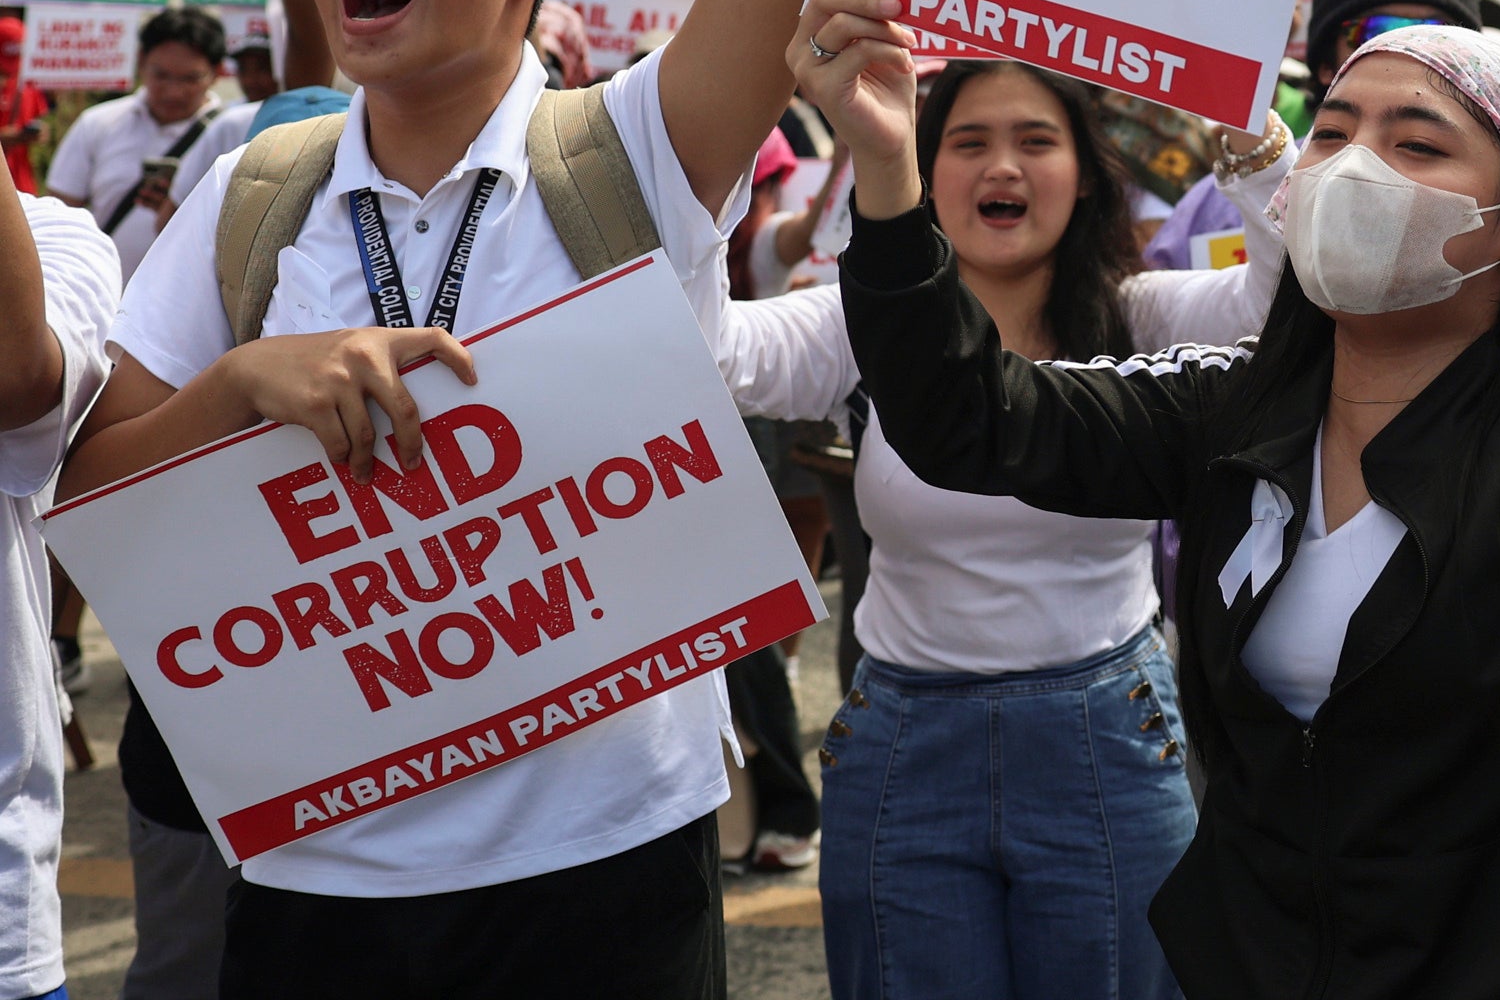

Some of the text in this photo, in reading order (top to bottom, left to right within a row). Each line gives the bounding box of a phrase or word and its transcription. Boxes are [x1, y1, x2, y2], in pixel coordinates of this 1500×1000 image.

[355, 193, 407, 328] PROVIDENTIAL COLLE
[438, 275, 463, 309] CITY
[450, 182, 494, 274] PROVIDENTIAL
[155, 418, 723, 689] CORRUPTION
[258, 403, 523, 565] END
[342, 556, 604, 712] NOW!
[292, 616, 750, 831] AKBAYAN PARTYLIST
